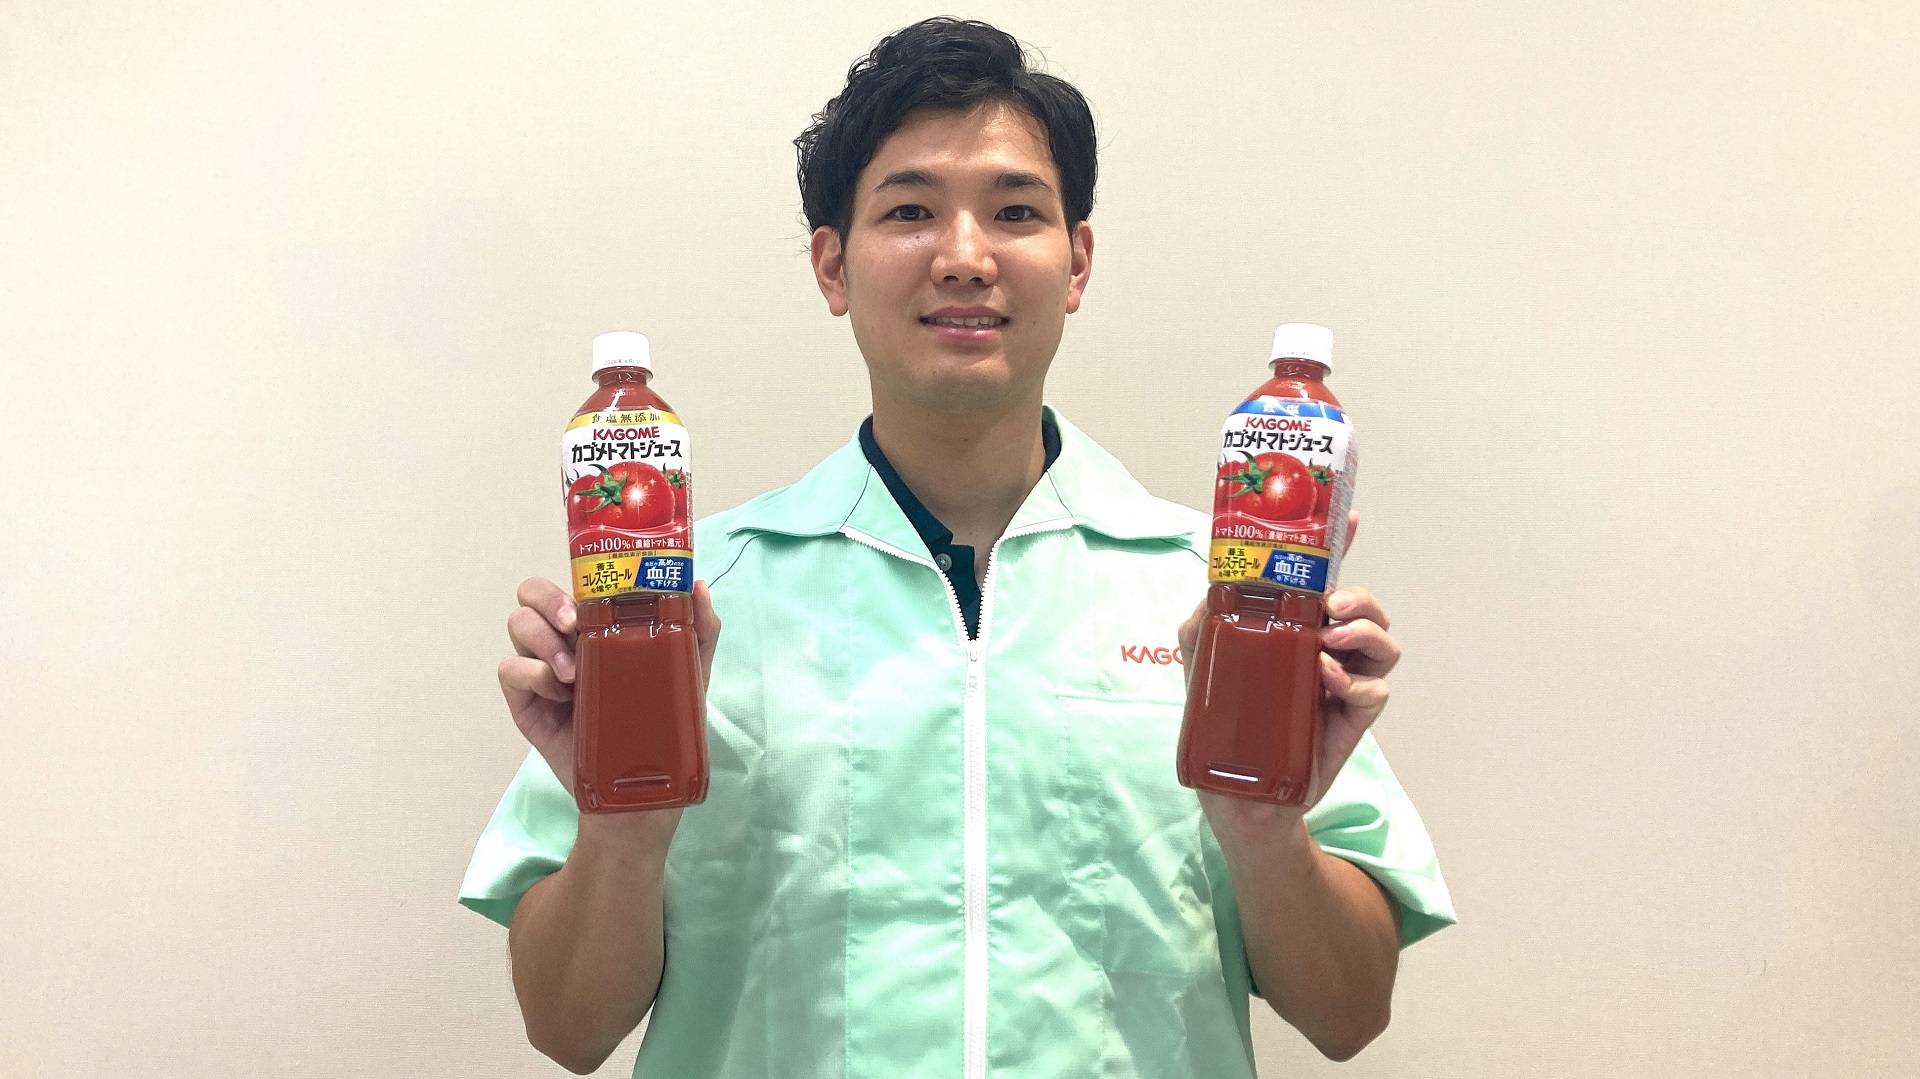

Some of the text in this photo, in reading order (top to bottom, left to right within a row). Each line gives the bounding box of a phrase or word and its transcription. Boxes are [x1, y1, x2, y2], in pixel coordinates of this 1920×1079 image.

[1245, 417, 1312, 431] KAGOME
[593, 426, 660, 440] KAGOME
[1223, 430, 1333, 454] カゴメトマトジュース
[572, 440, 682, 463] カゴメトマトジュース
[1212, 556, 1259, 570] コレステロール
[1273, 560, 1311, 579] 血圧
[582, 568, 632, 587] コレステロール
[646, 565, 682, 580] 血圧
